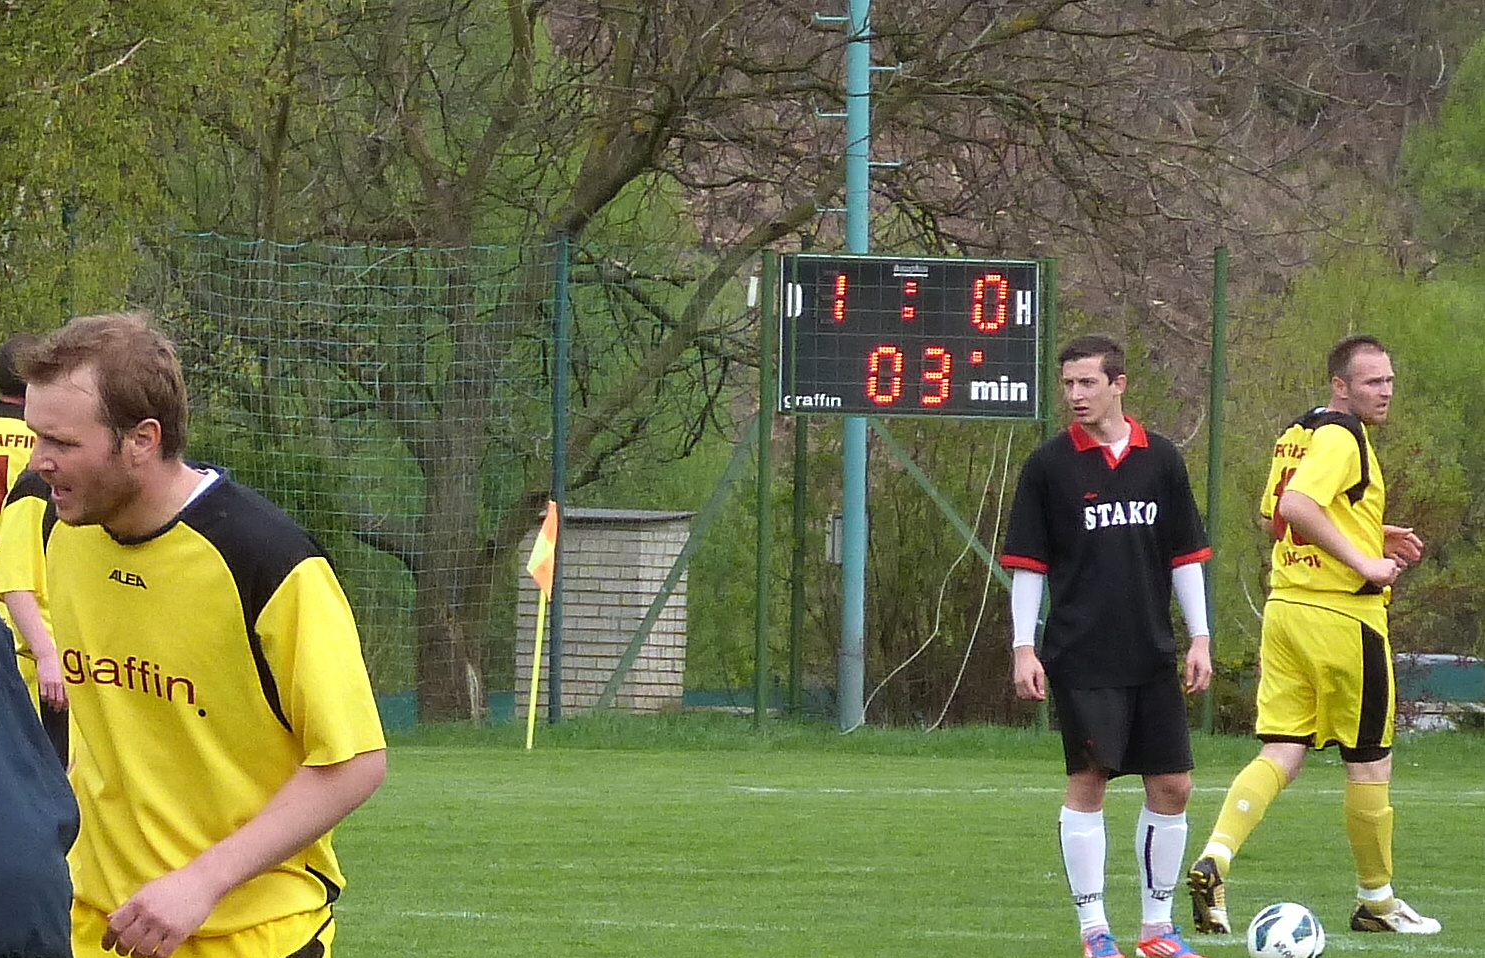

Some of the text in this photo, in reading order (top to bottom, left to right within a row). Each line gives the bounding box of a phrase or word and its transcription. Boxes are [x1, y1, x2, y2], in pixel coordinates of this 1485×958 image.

[833, 273, 847, 322] 1
[971, 272, 1009, 332] 0
[1016, 290, 1031, 325] H
[866, 346, 1028, 405] 03 min
[784, 393, 842, 409] graffin
[1084, 501, 1157, 530] STAKO
